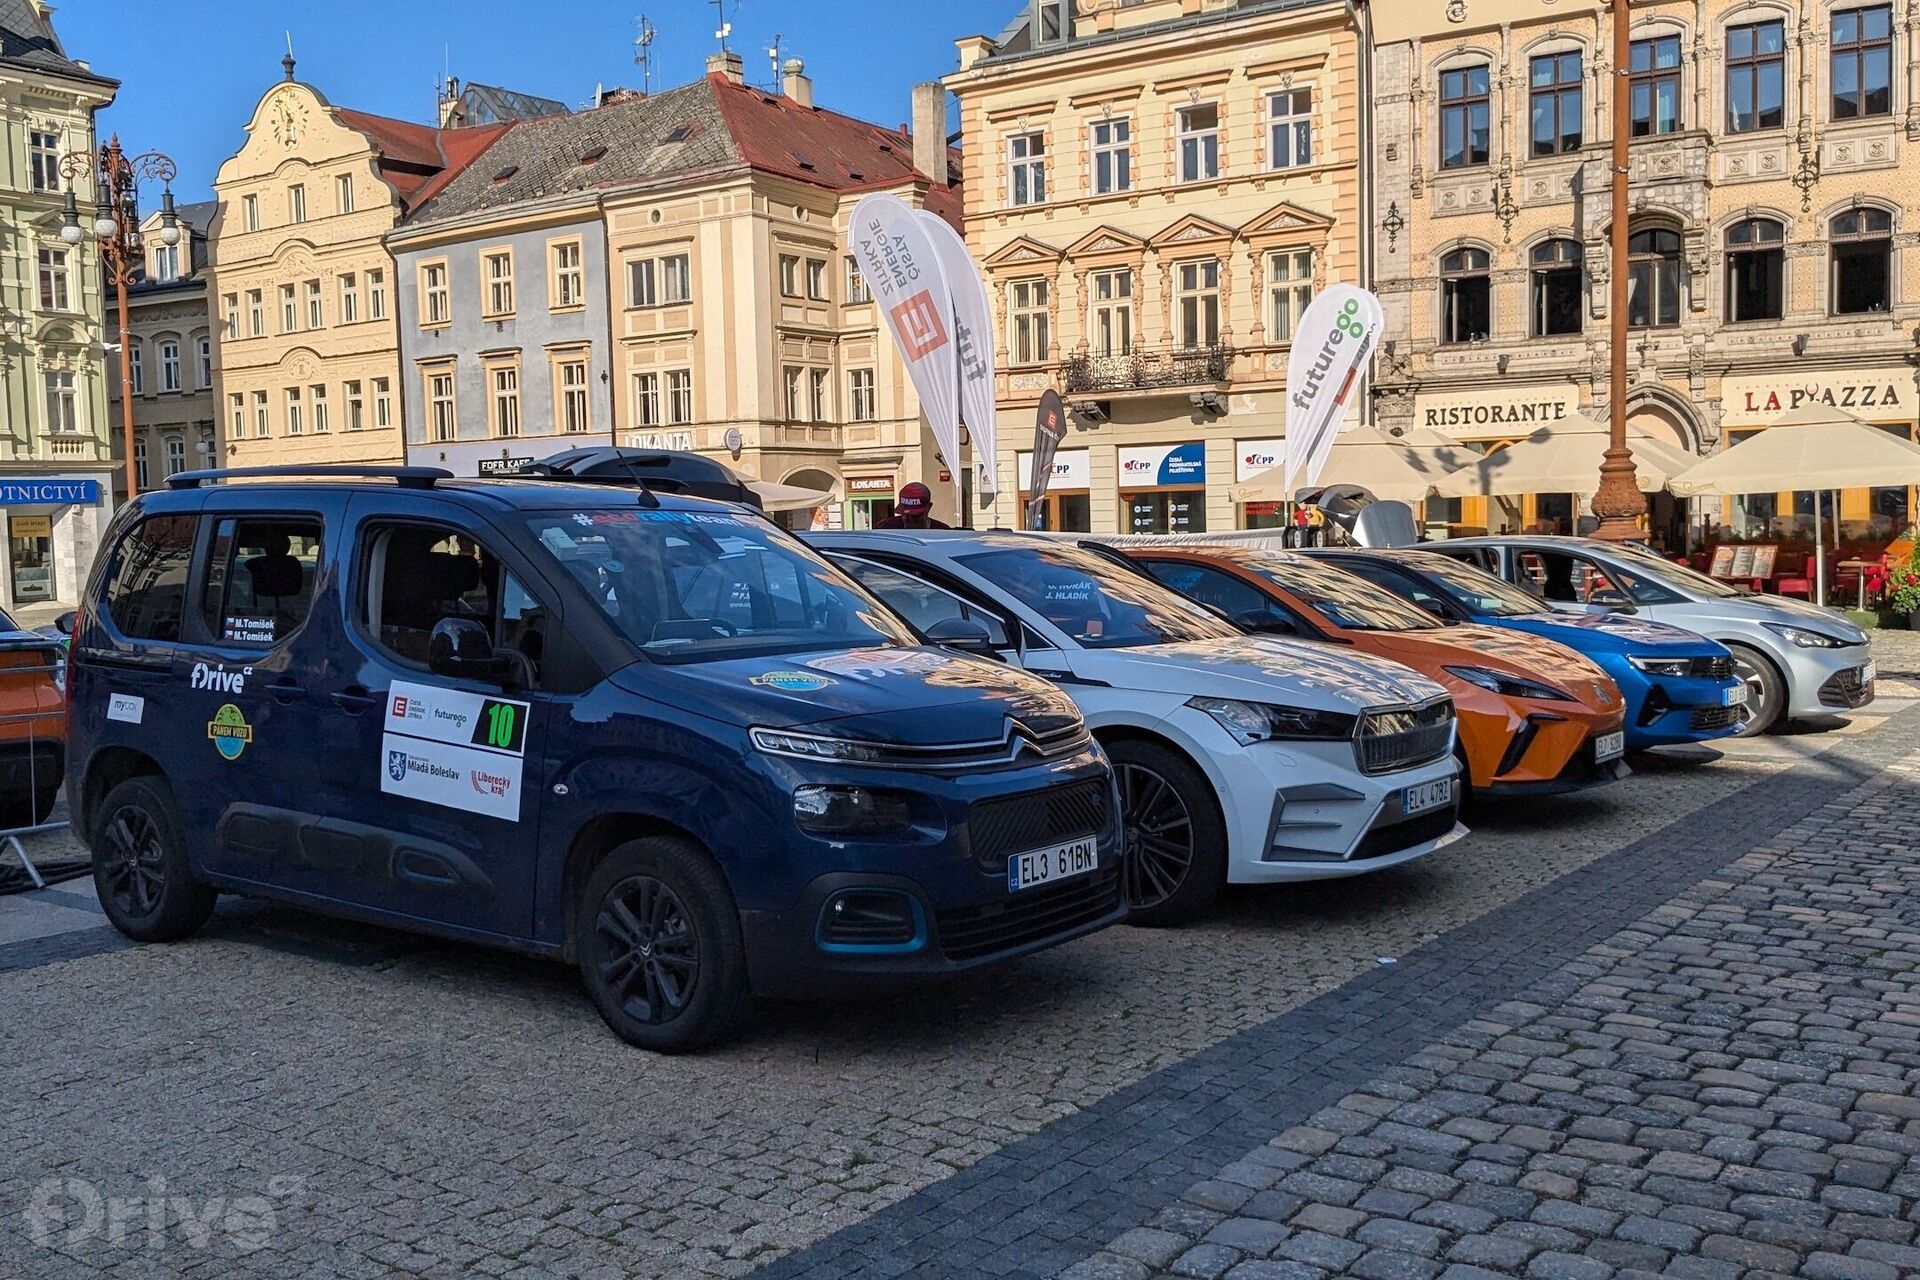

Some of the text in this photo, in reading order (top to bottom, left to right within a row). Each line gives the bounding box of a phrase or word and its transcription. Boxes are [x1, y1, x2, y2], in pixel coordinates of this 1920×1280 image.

[1744, 391, 1781, 412] LA
[1425, 402, 1567, 426] RISTORANTE
[0, 482, 86, 500] TNICTVÍ
[489, 703, 514, 747] 10
[407, 760, 460, 780] Mladá Boleslav
[478, 771, 511, 789] Liberecký
[491, 783, 504, 797] kraj
[1022, 853, 1048, 885] EL3
[1059, 841, 1092, 874] 61BN
